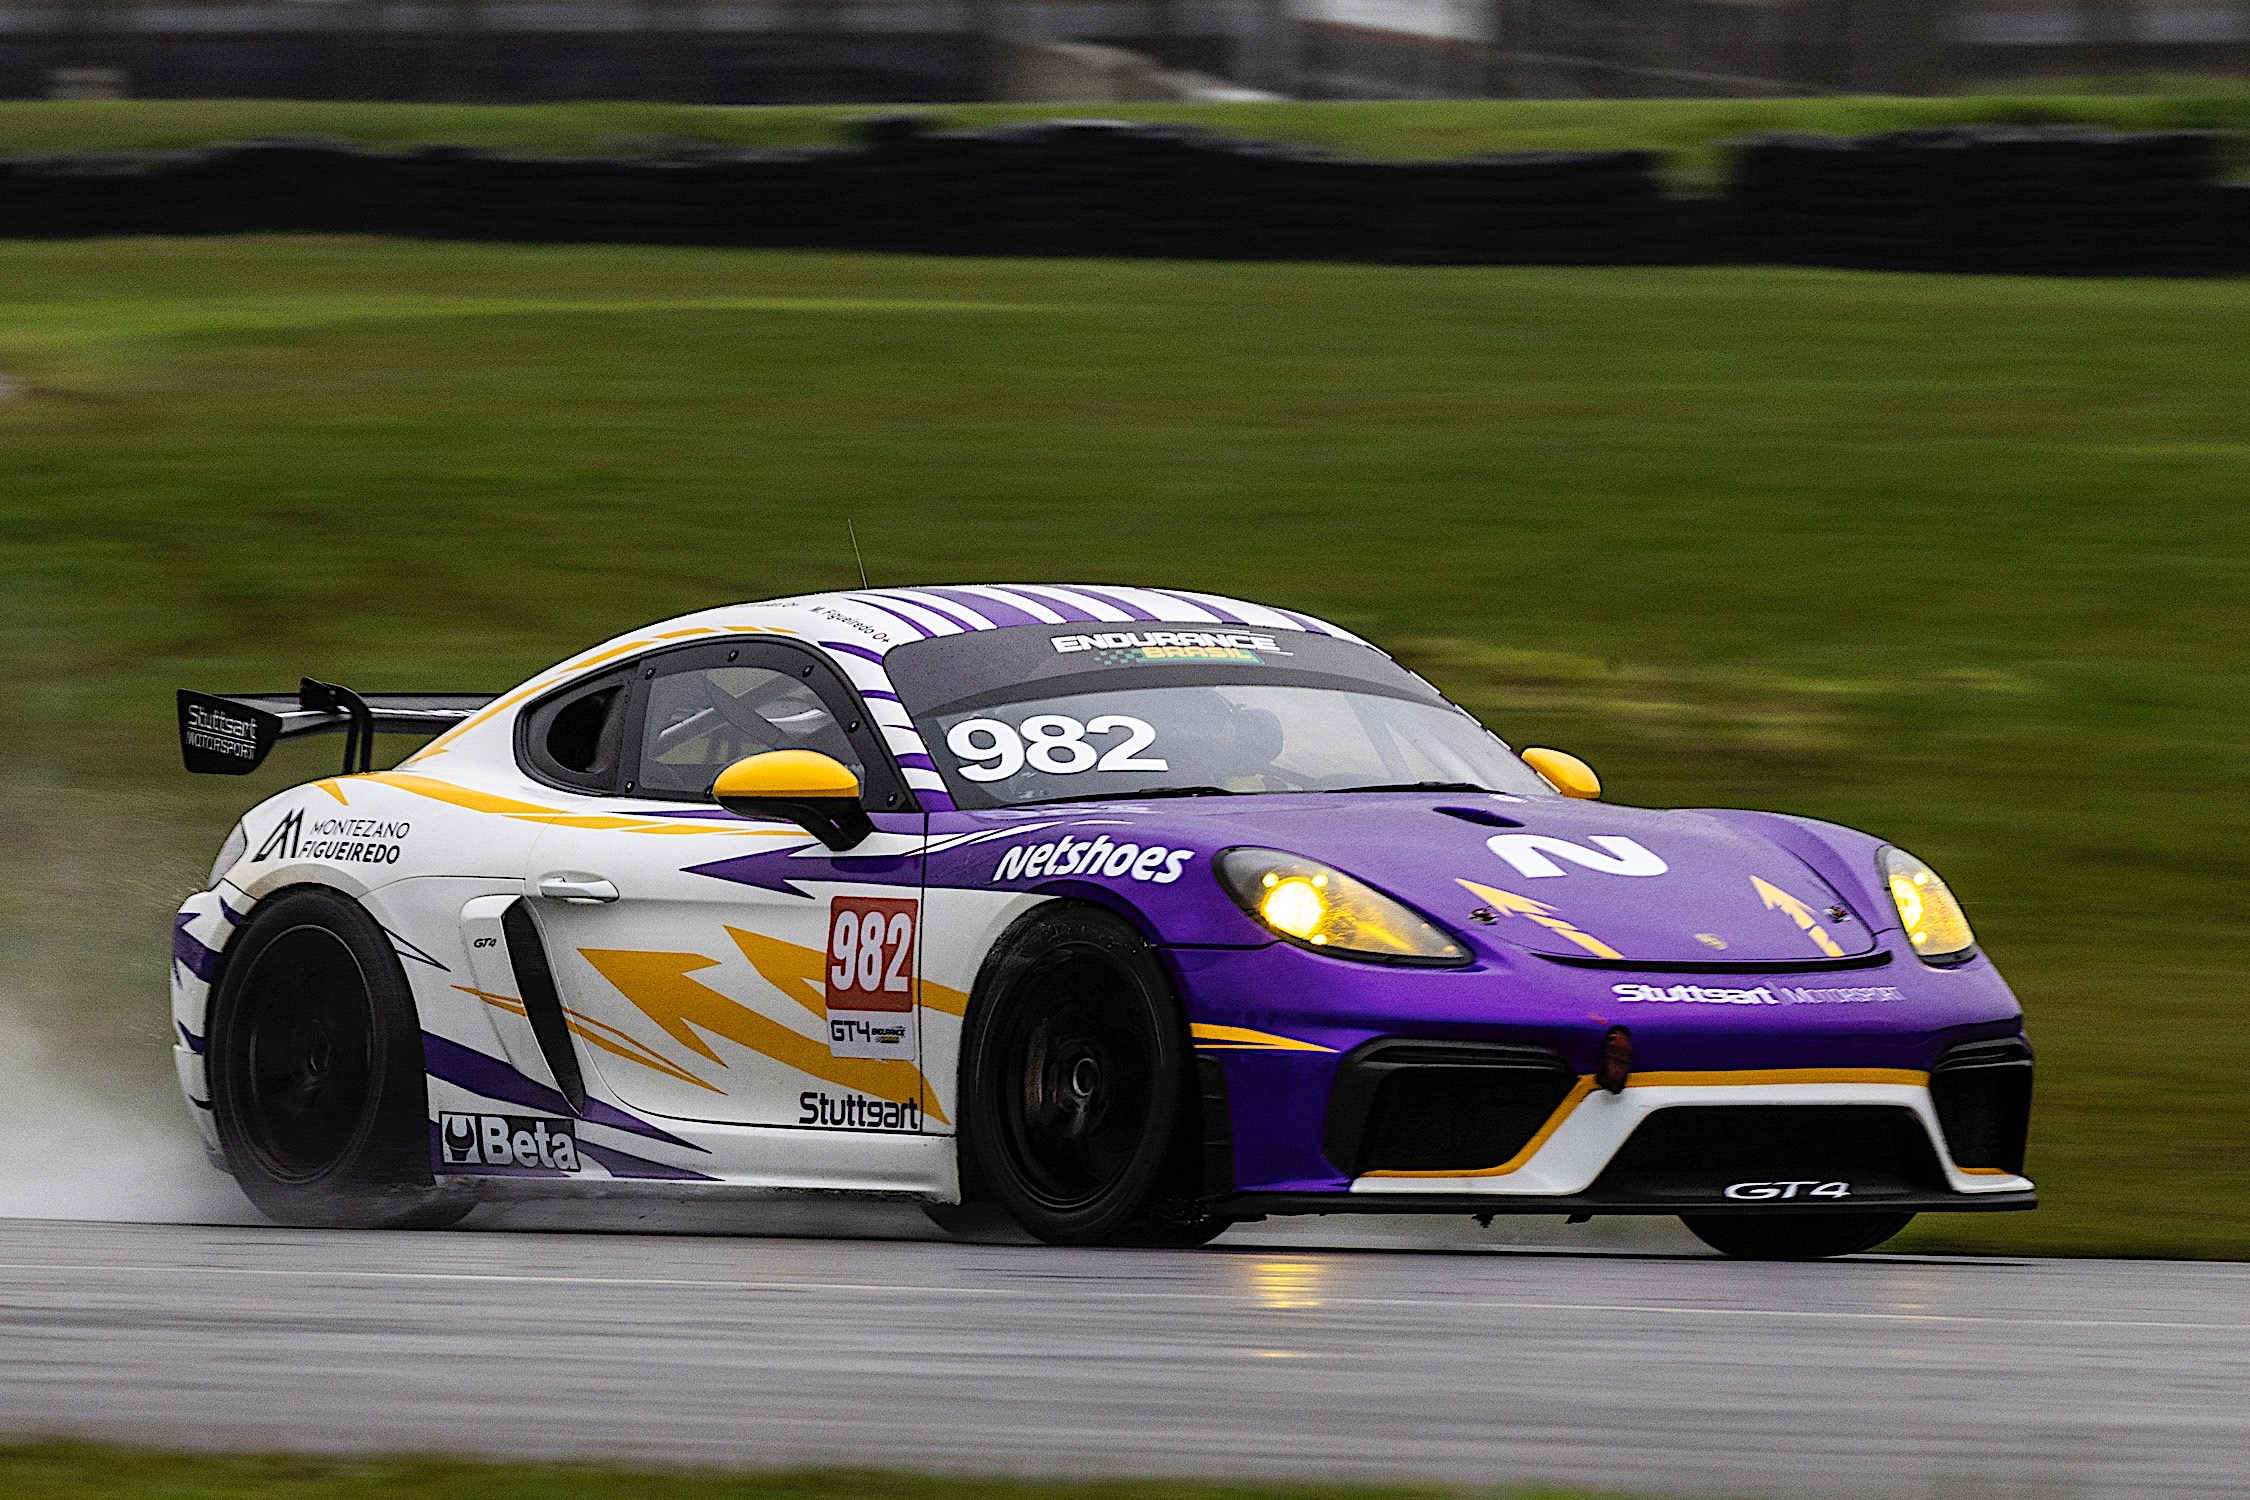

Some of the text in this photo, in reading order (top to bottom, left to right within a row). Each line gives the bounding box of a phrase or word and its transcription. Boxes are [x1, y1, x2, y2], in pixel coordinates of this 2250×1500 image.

[821, 609, 875, 634] Figueiredo
[1051, 632, 1281, 653] ENDURANCE
[1142, 646, 1252, 660] BRASIL
[185, 731, 257, 760] MOTORSPORT
[946, 714, 1169, 782] 982
[311, 819, 411, 840] MONTEZANO
[299, 840, 401, 865] FIGUEIREDO
[992, 834, 1195, 884] Netshoes
[473, 937, 497, 948] GT4
[831, 910, 912, 993] 982
[1611, 983, 1781, 1005] Stuttgart
[831, 1019, 871, 1043] GT4
[798, 1091, 918, 1130] Stuttgart
[480, 1116, 580, 1171] Beta
[1723, 1181, 1852, 1199] GT4
